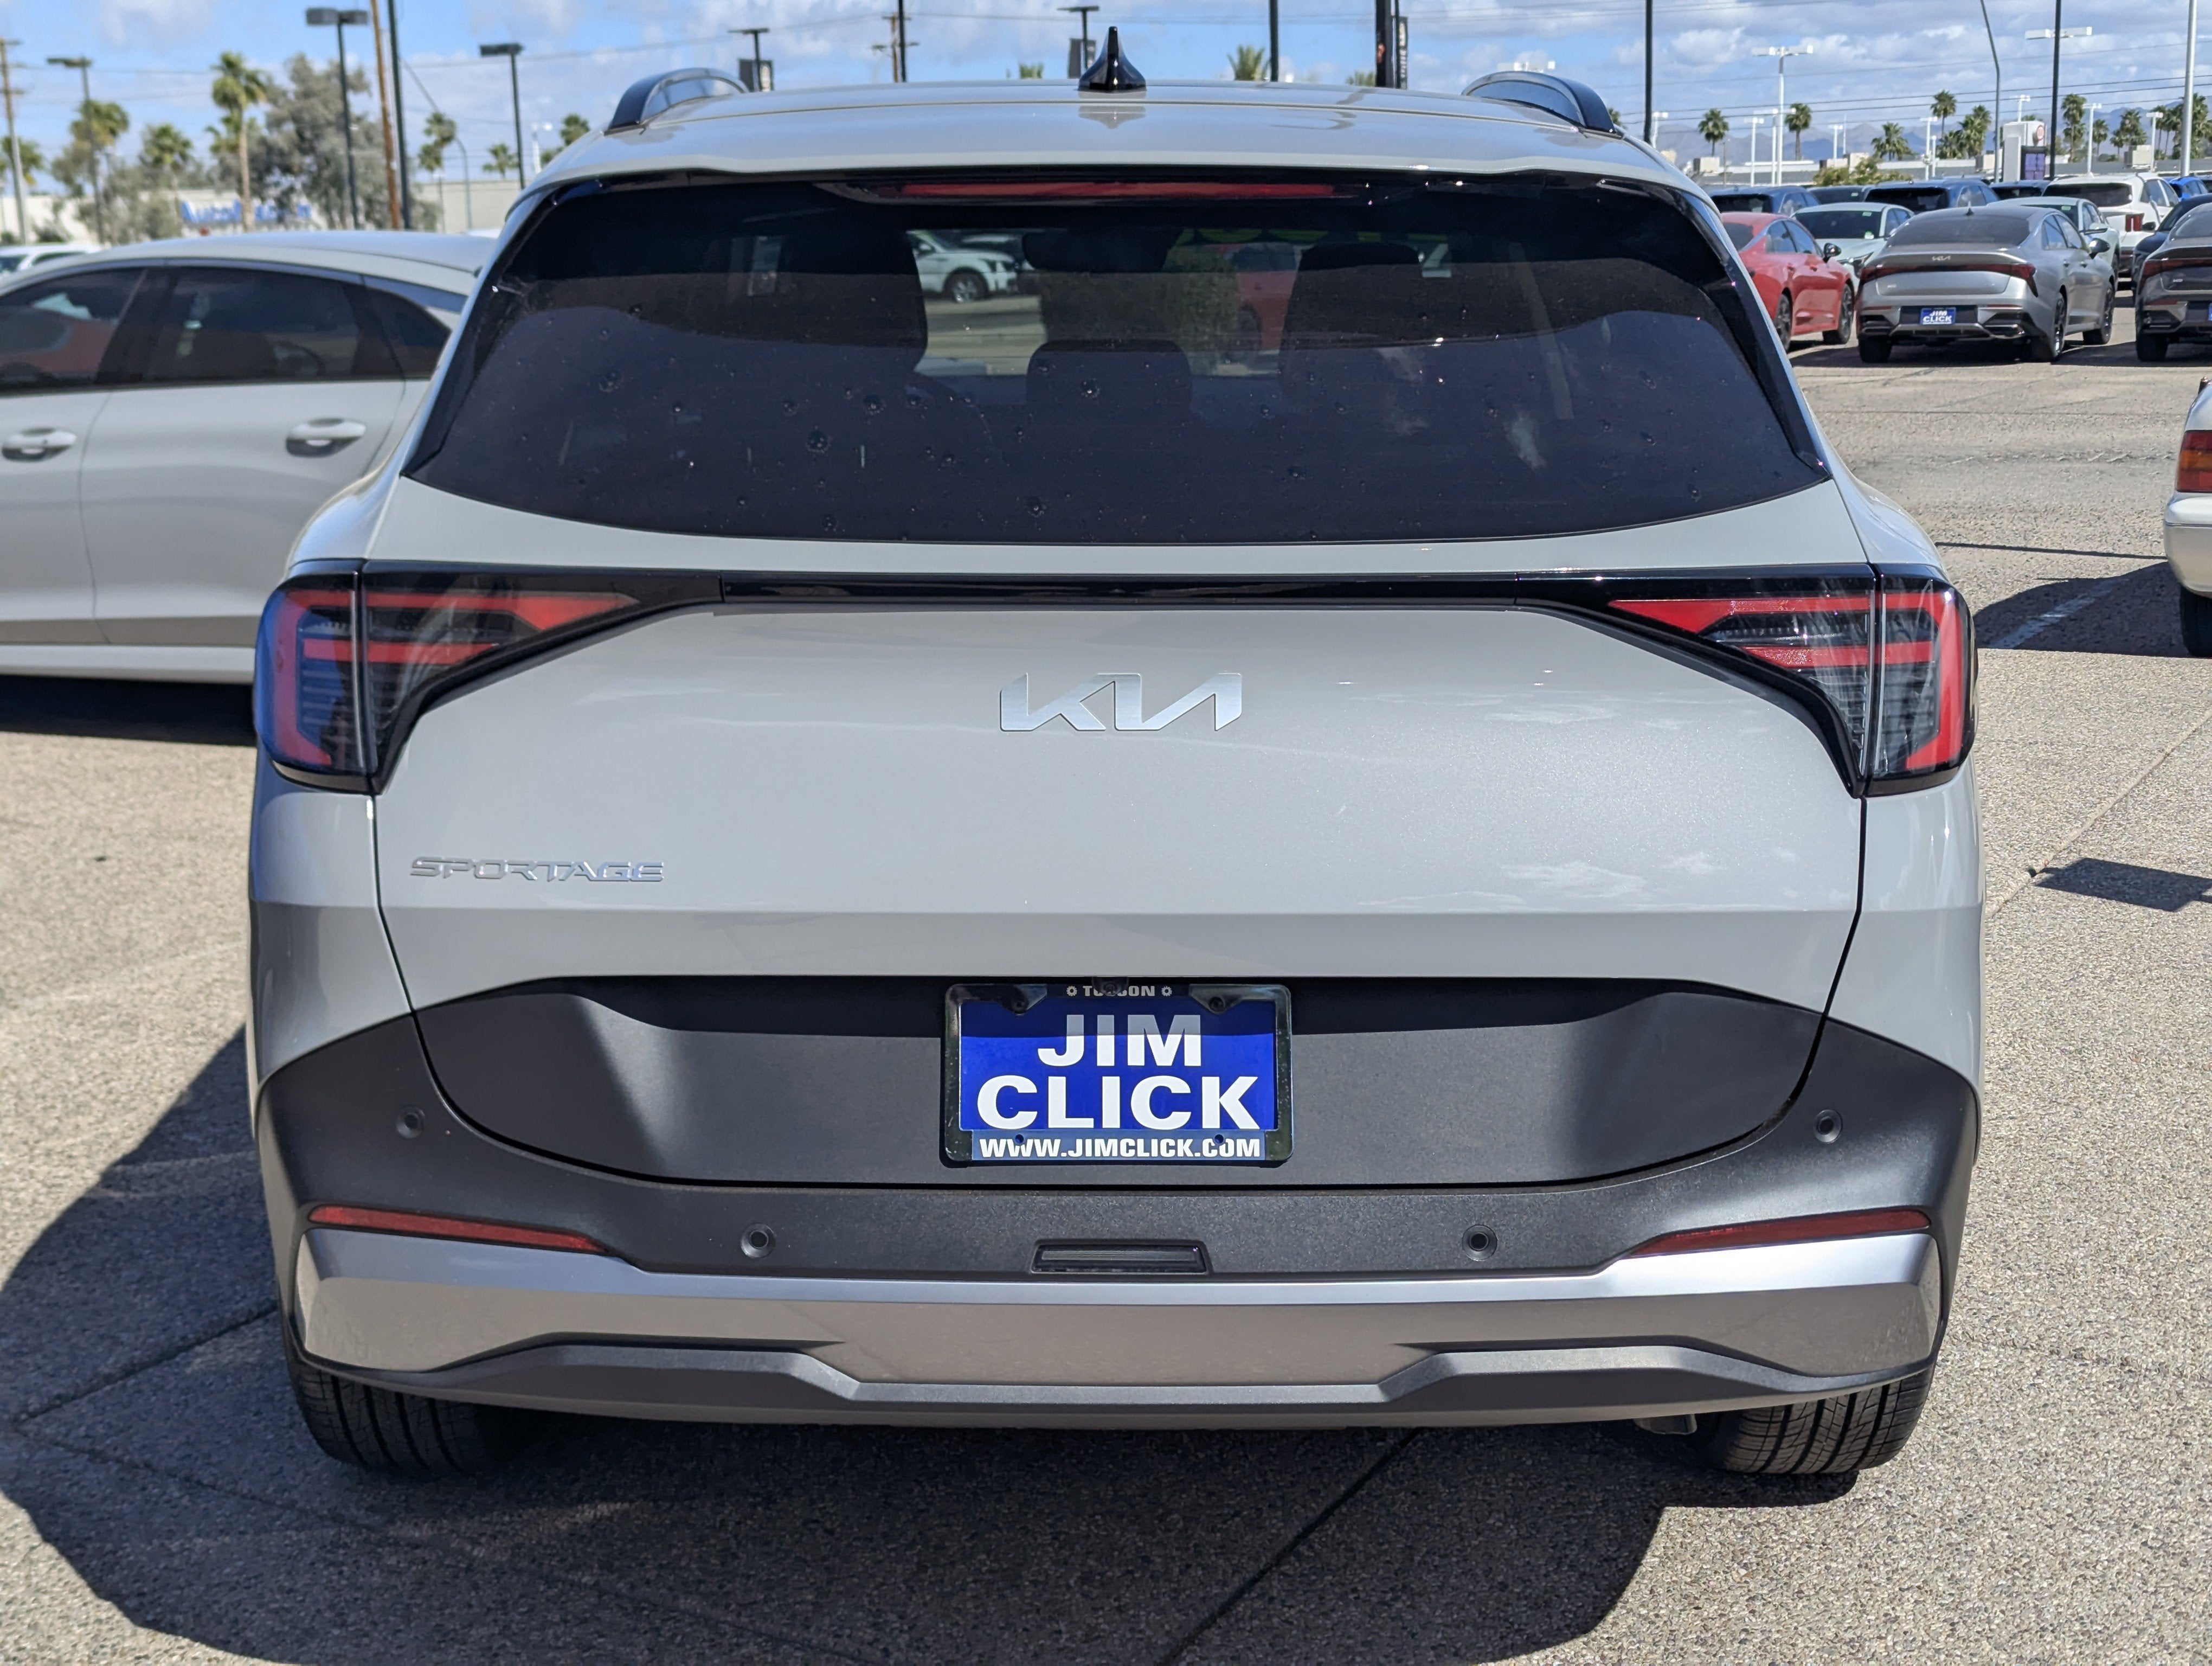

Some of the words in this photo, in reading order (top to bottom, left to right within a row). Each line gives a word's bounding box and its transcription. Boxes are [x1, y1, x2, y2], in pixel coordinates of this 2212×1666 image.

[999, 672, 1242, 732] KIA
[410, 856, 664, 882] SPORTAGE
[1082, 985, 1155, 997] TUSON
[1037, 1014, 1201, 1067] JIM
[976, 1075, 1260, 1130] CLICK
[979, 1138, 1261, 1158] WWW.JIMCLICK.COM
